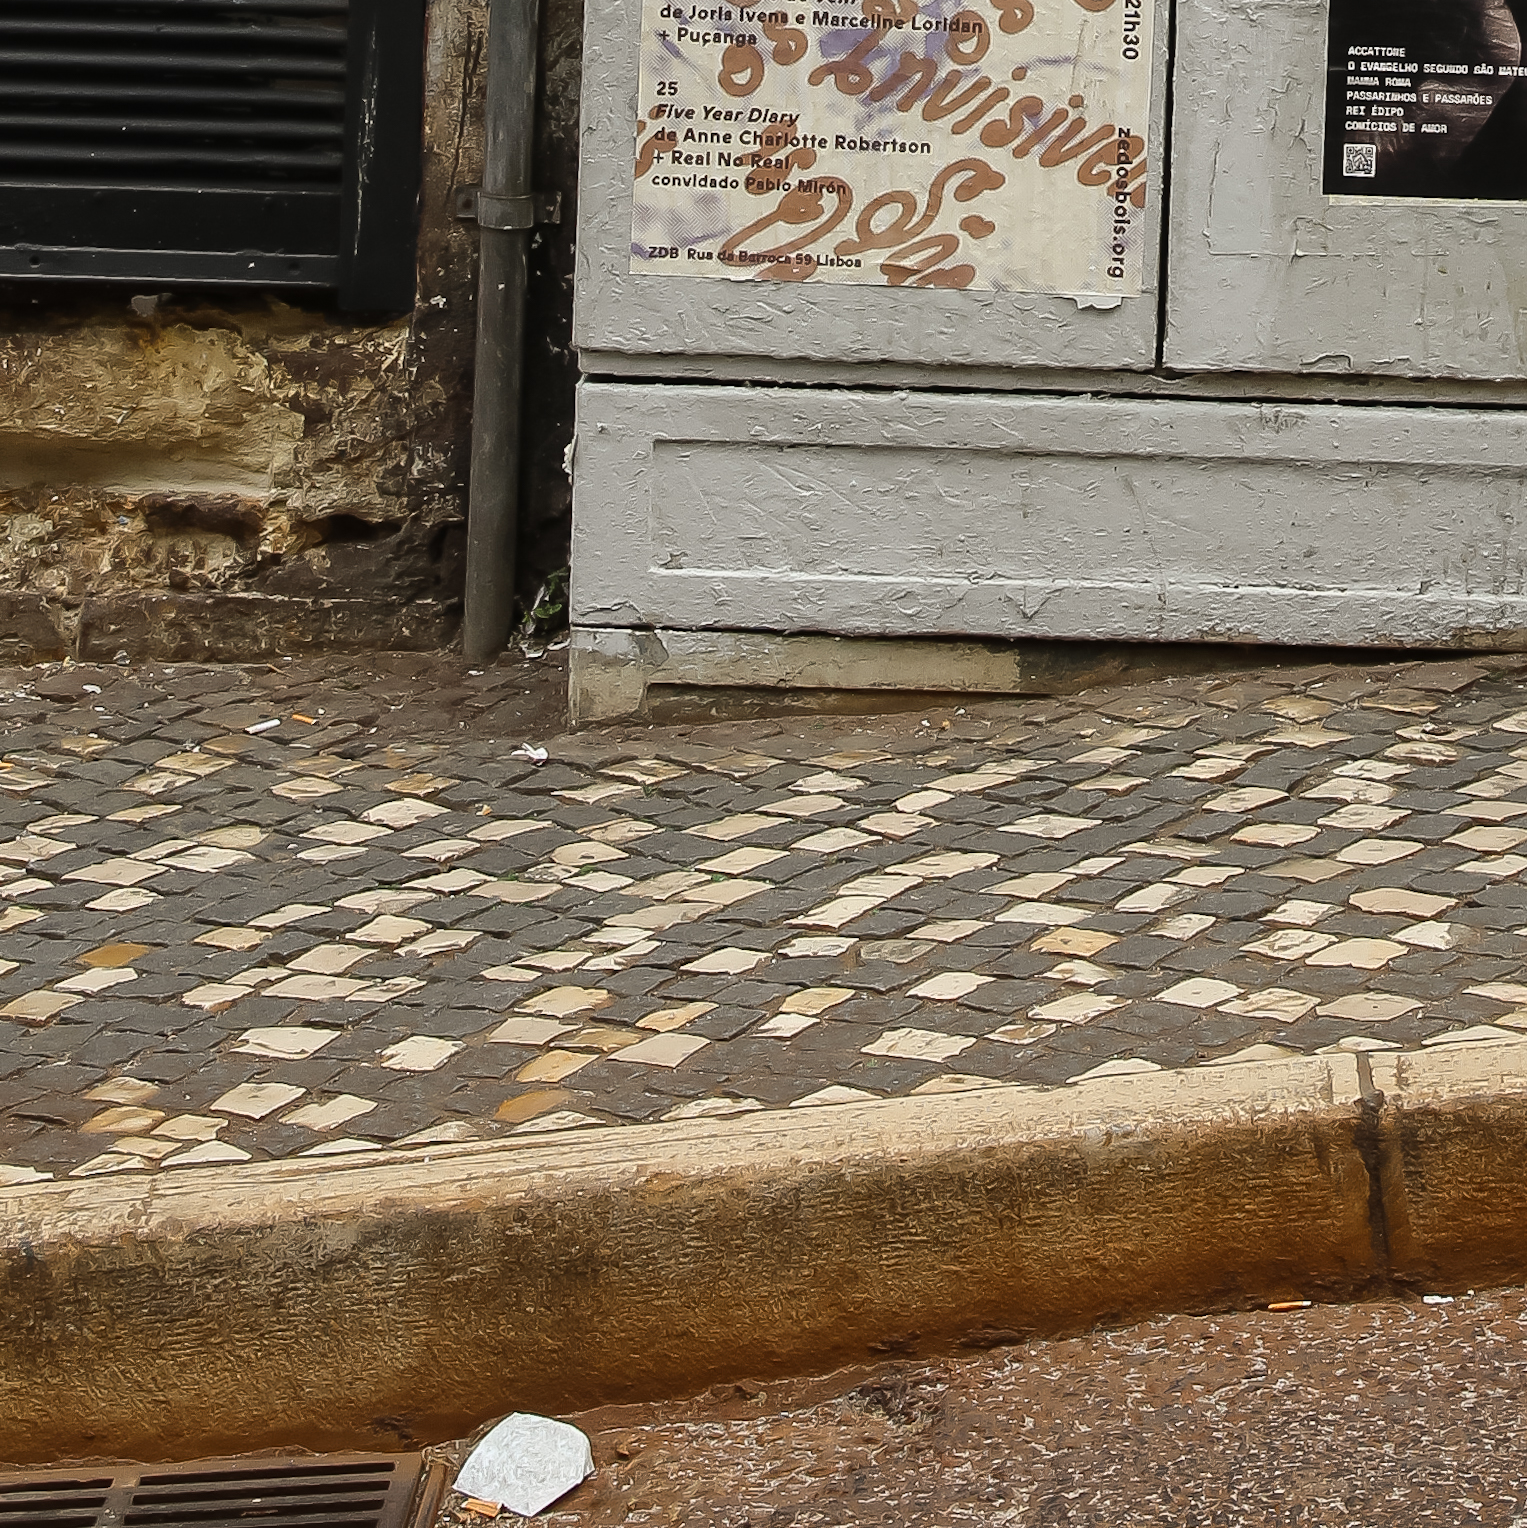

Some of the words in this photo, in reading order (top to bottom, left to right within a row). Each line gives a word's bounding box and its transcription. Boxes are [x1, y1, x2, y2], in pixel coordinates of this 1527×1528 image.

[659, 3, 683, 21] de
[688, 5, 733, 22] Joris
[739, 7, 789, 25] Ivens
[795, 13, 806, 26] e
[811, 10, 905, 30] Marceline
[910, 15, 983, 34] Loridan
[676, 25, 757, 47] Puçanga
[1347, 46, 1407, 58] ACCATTONE
[1347, 61, 1356, 71] O
[1360, 61, 1419, 73] EVANGELHO
[1423, 63, 1469, 74] SEGUNDO
[1473, 63, 1494, 75] SÃO
[656, 80, 679, 96] 25
[1346, 91, 1418, 103] PASSARINHOS
[1422, 93, 1430, 103] E
[1434, 93, 1494, 106] PASSARÕES
[655, 103, 696, 121] Five
[702, 105, 745, 123] Year
[749, 107, 801, 127] Diary
[1345, 105, 1366, 116] REI
[1371, 104, 1405, 117] ÉDIPO
[1344, 119, 1398, 132] COMÍCIOS
[1402, 122, 1416, 132] DE
[1420, 123, 1448, 134] AMOR
[654, 127, 678, 143] de
[683, 127, 733, 144] Anne
[738, 130, 829, 151] Charlotte
[834, 134, 932, 155] Robertson
[671, 149, 711, 167] Real
[717, 152, 744, 168] No
[750, 153, 791, 171] Real
[651, 173, 740, 190] convidado
[745, 175, 792, 193] Pablo
[797, 178, 847, 195] Mirón
[1107, 126, 1133, 280] zedosbois.org
[647, 246, 680, 260] ZDB
[687, 247, 714, 261] Rua
[738, 250, 792, 265] Barroca
[816, 254, 863, 268] Lisboa
